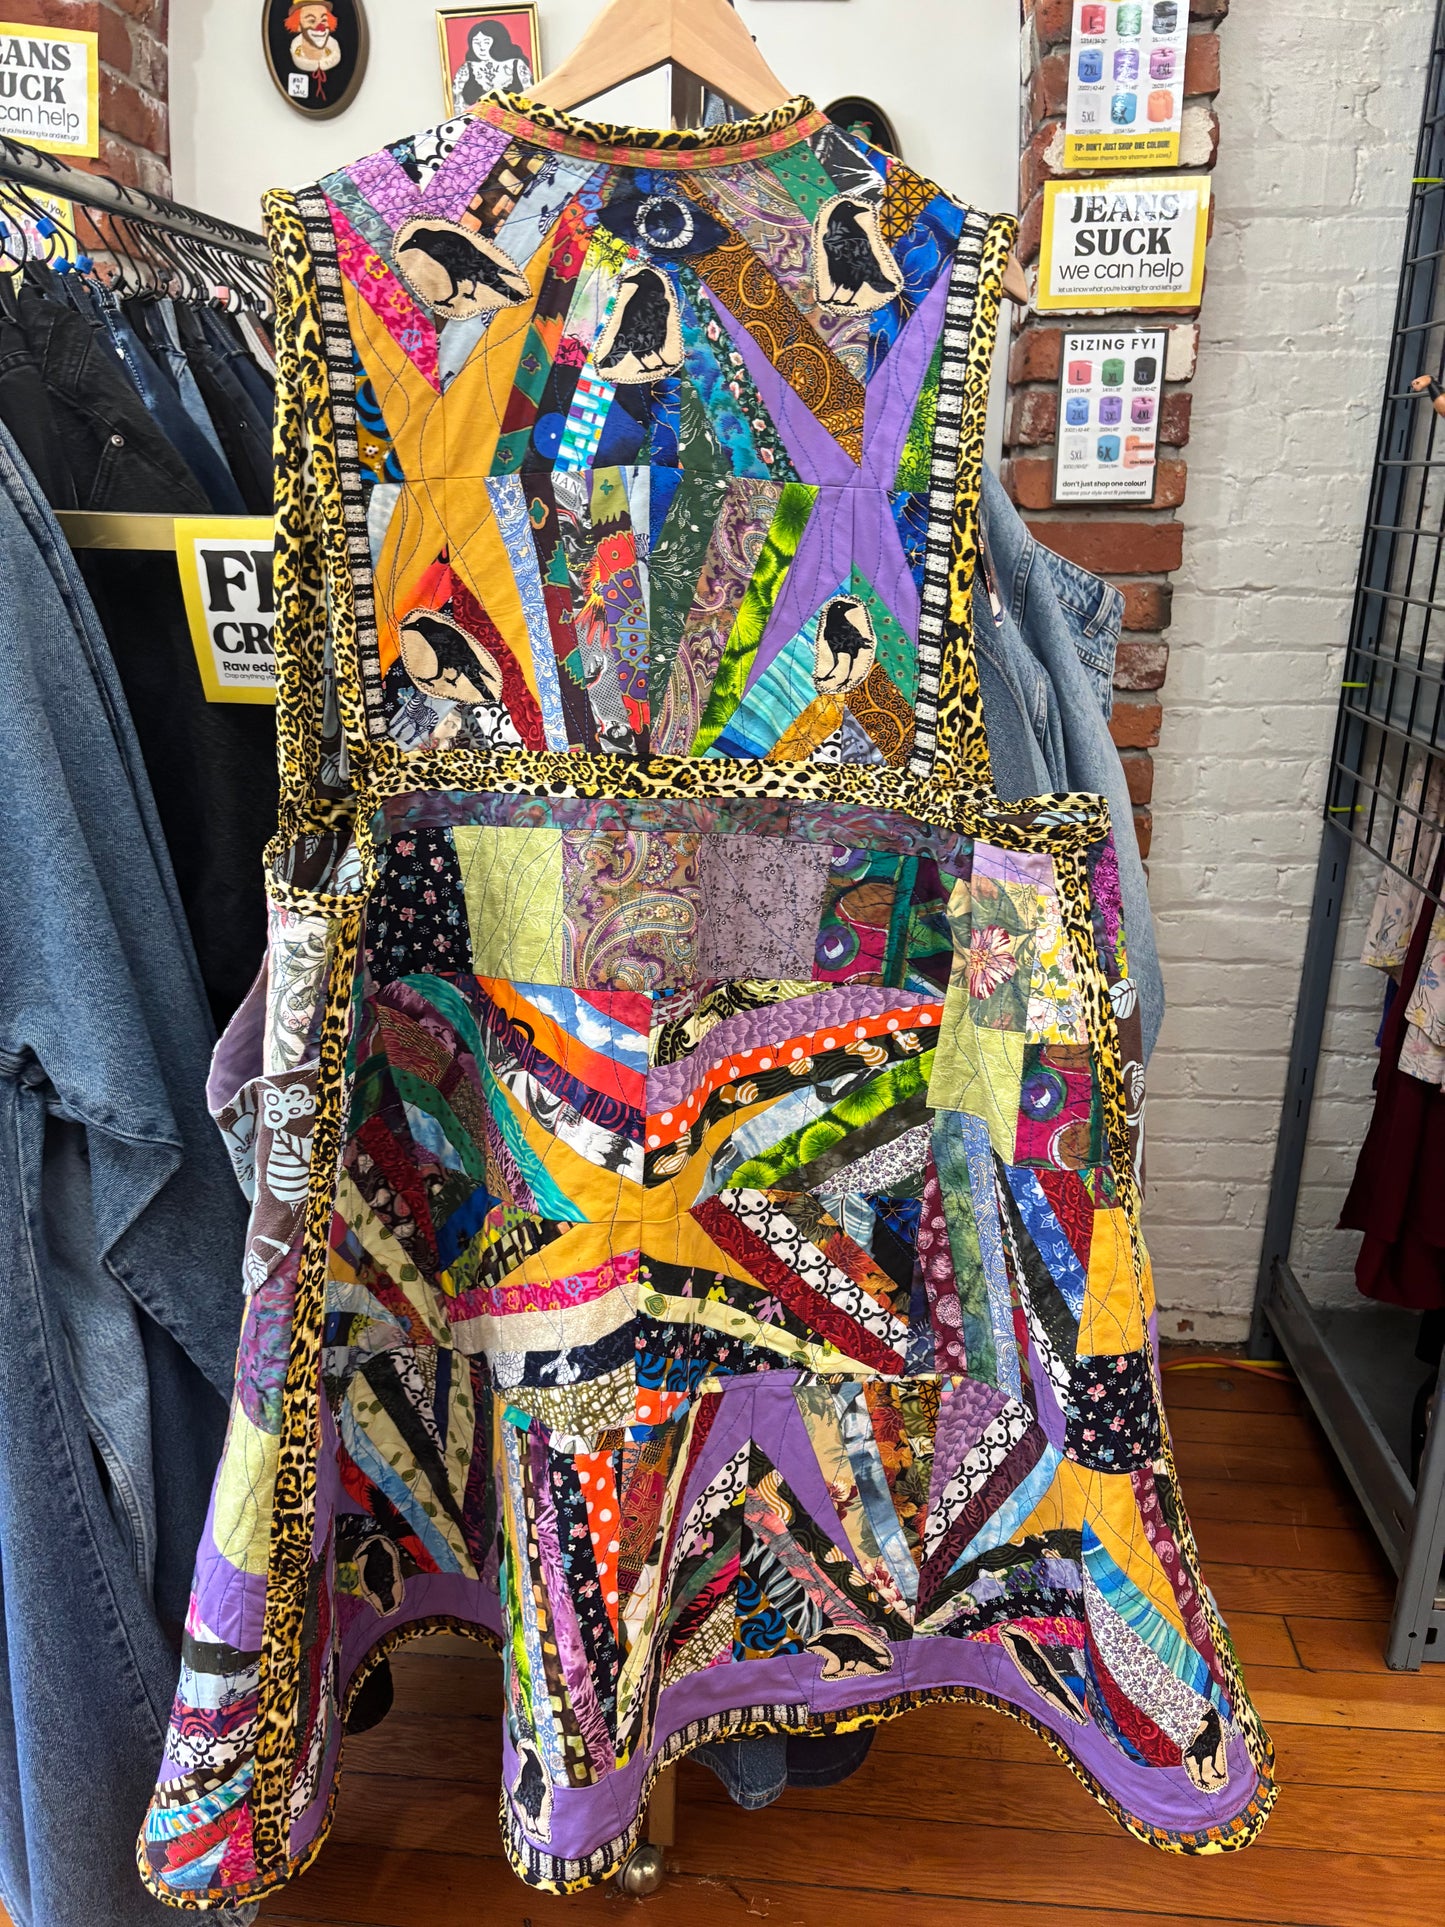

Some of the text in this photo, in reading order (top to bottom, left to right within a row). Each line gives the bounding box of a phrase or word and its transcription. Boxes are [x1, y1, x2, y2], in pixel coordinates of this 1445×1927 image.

[0, 38, 71, 71] ANS
[0, 104, 80, 133] can help
[1081, 111, 1095, 123] 5XL
[1103, 143, 1117, 151] JUST
[1118, 142, 1133, 150] SHOP
[50, 203, 67, 219] you
[1070, 193, 1180, 224] JEANS
[1074, 227, 1172, 257] SUCK
[1059, 258, 1184, 283] we can help
[1070, 338, 1156, 351] SIZING FYI
[1071, 409, 1085, 420] 2XL
[1104, 411, 1117, 422] 3XL
[1137, 409, 1151, 420] 4XL
[1070, 450, 1082, 461] 5XL
[1080, 480, 1093, 488] just
[1094, 480, 1110, 488] shop
[1124, 479, 1147, 487] colour!
[222, 661, 250, 672] Raw
[240, 672, 265, 681] anything
